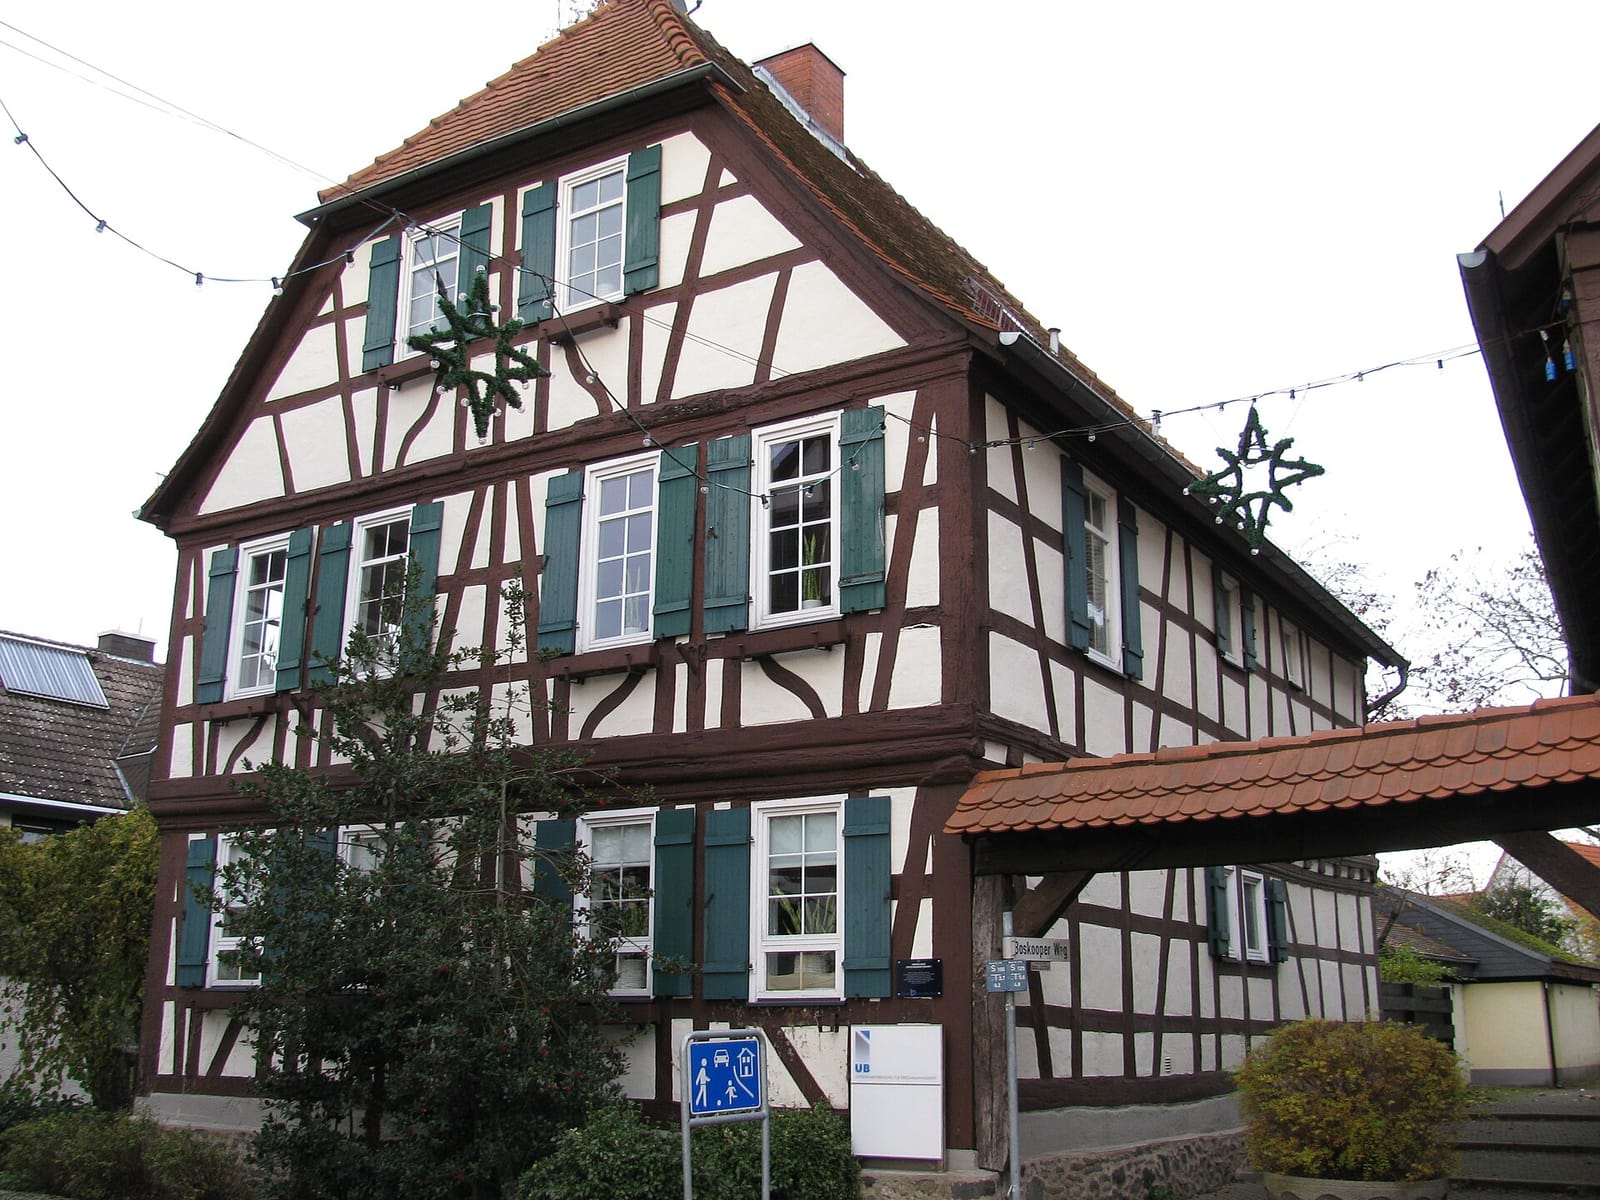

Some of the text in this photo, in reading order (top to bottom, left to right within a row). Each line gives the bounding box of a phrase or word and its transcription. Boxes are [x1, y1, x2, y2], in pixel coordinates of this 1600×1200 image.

[1011, 940, 1068, 960] Boskooper Weg
[855, 1063, 870, 1073] UB
